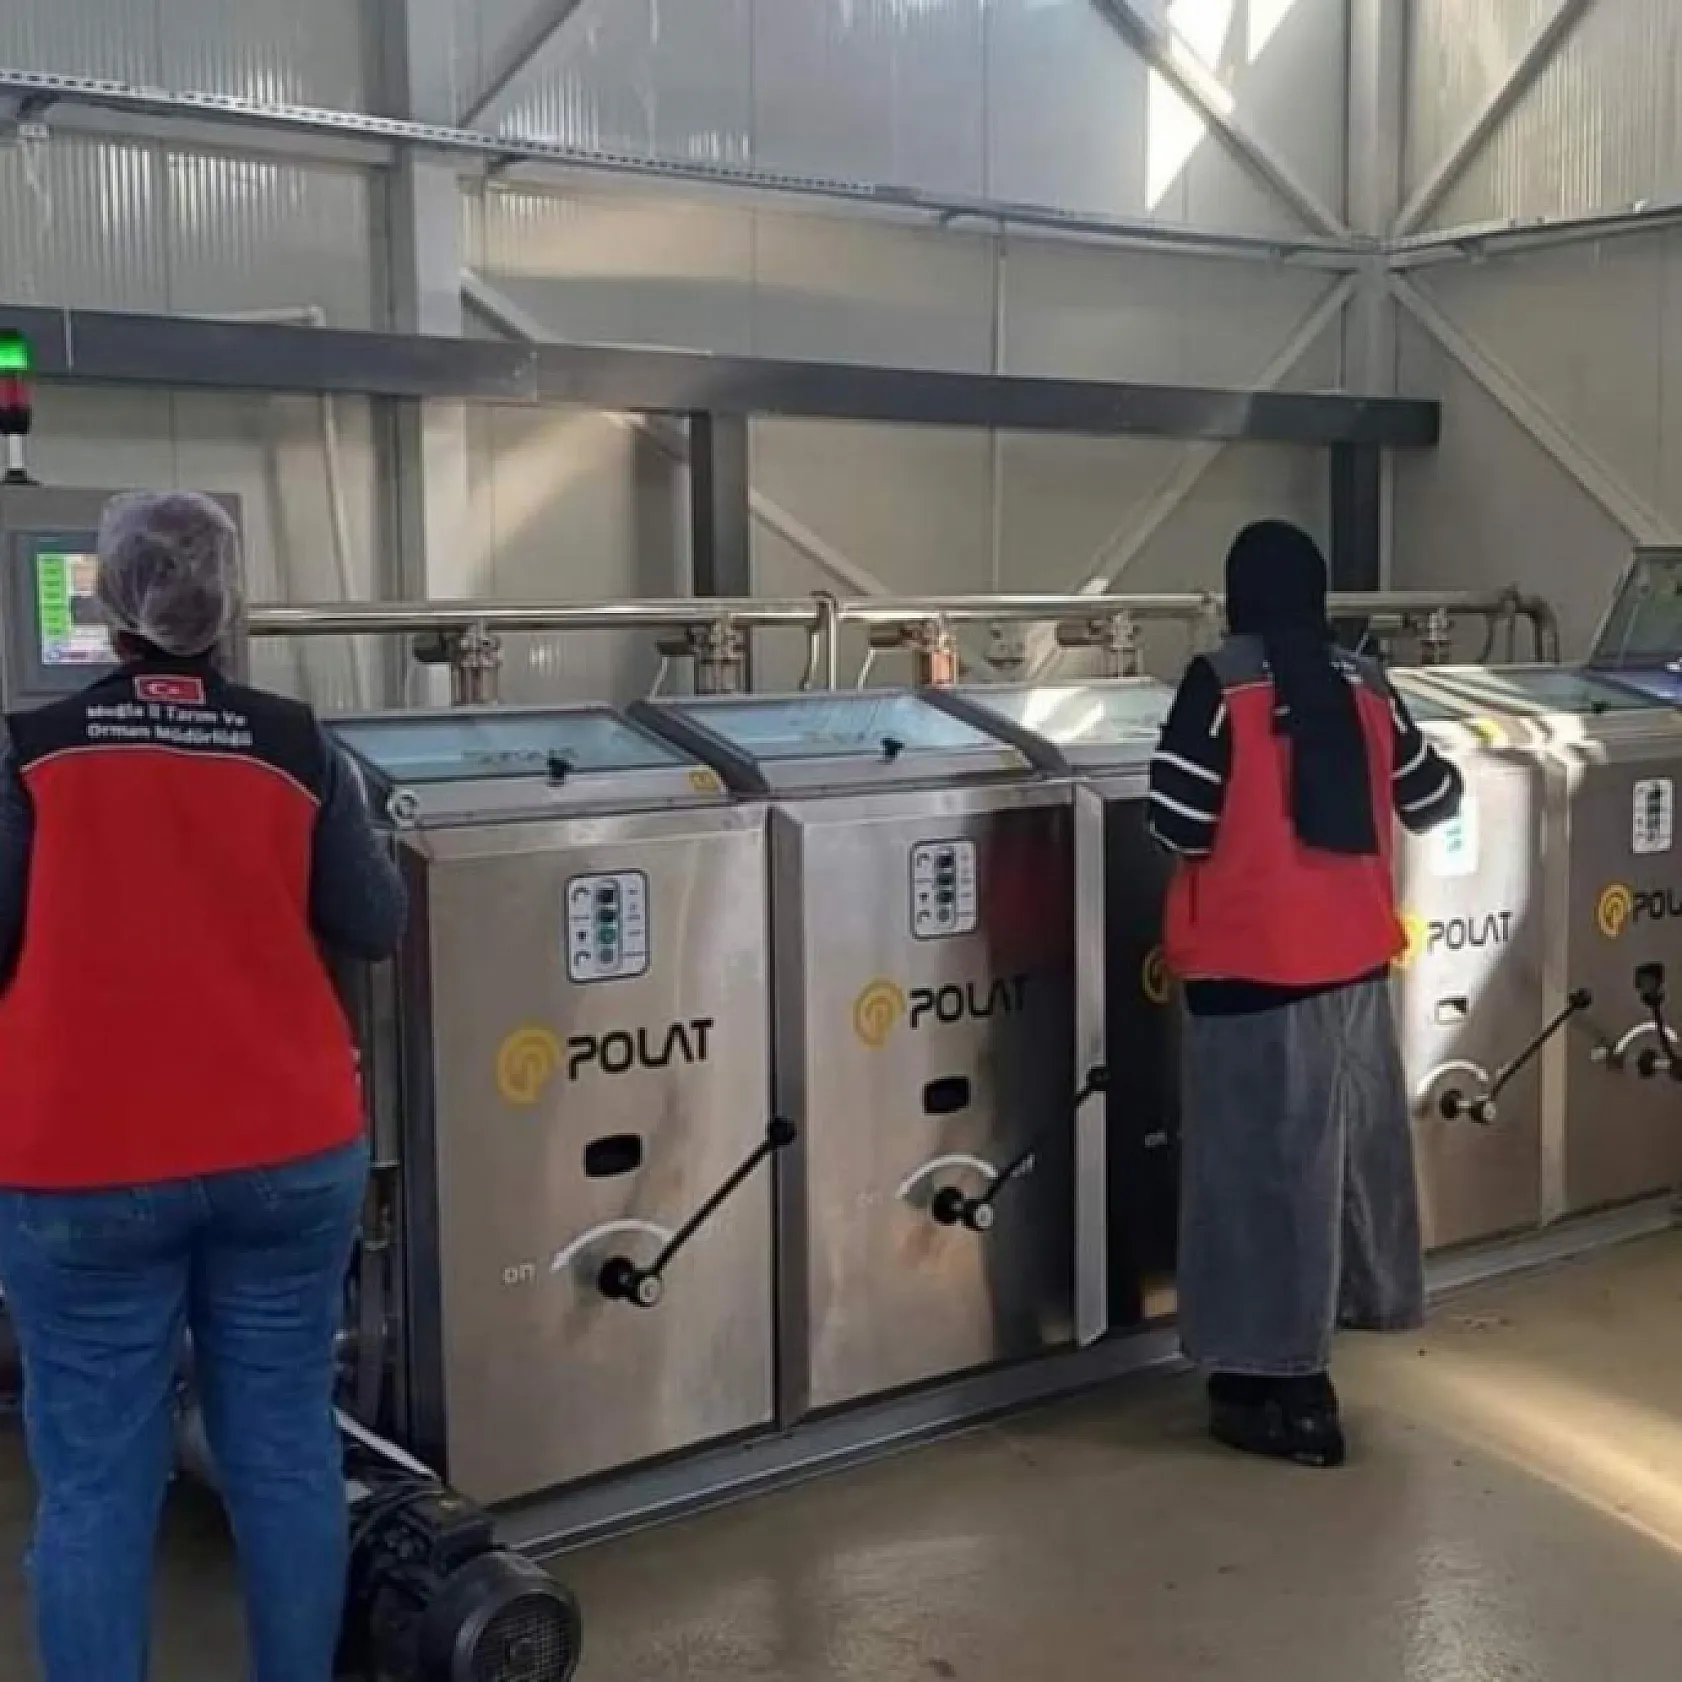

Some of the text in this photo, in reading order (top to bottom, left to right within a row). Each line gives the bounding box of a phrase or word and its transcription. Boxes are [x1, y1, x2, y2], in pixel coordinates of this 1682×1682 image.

[1632, 887, 1682, 924] POL
[1427, 911, 1513, 955] POLAT
[910, 975, 1027, 1030] POLAT
[568, 1018, 713, 1082] POLAT
